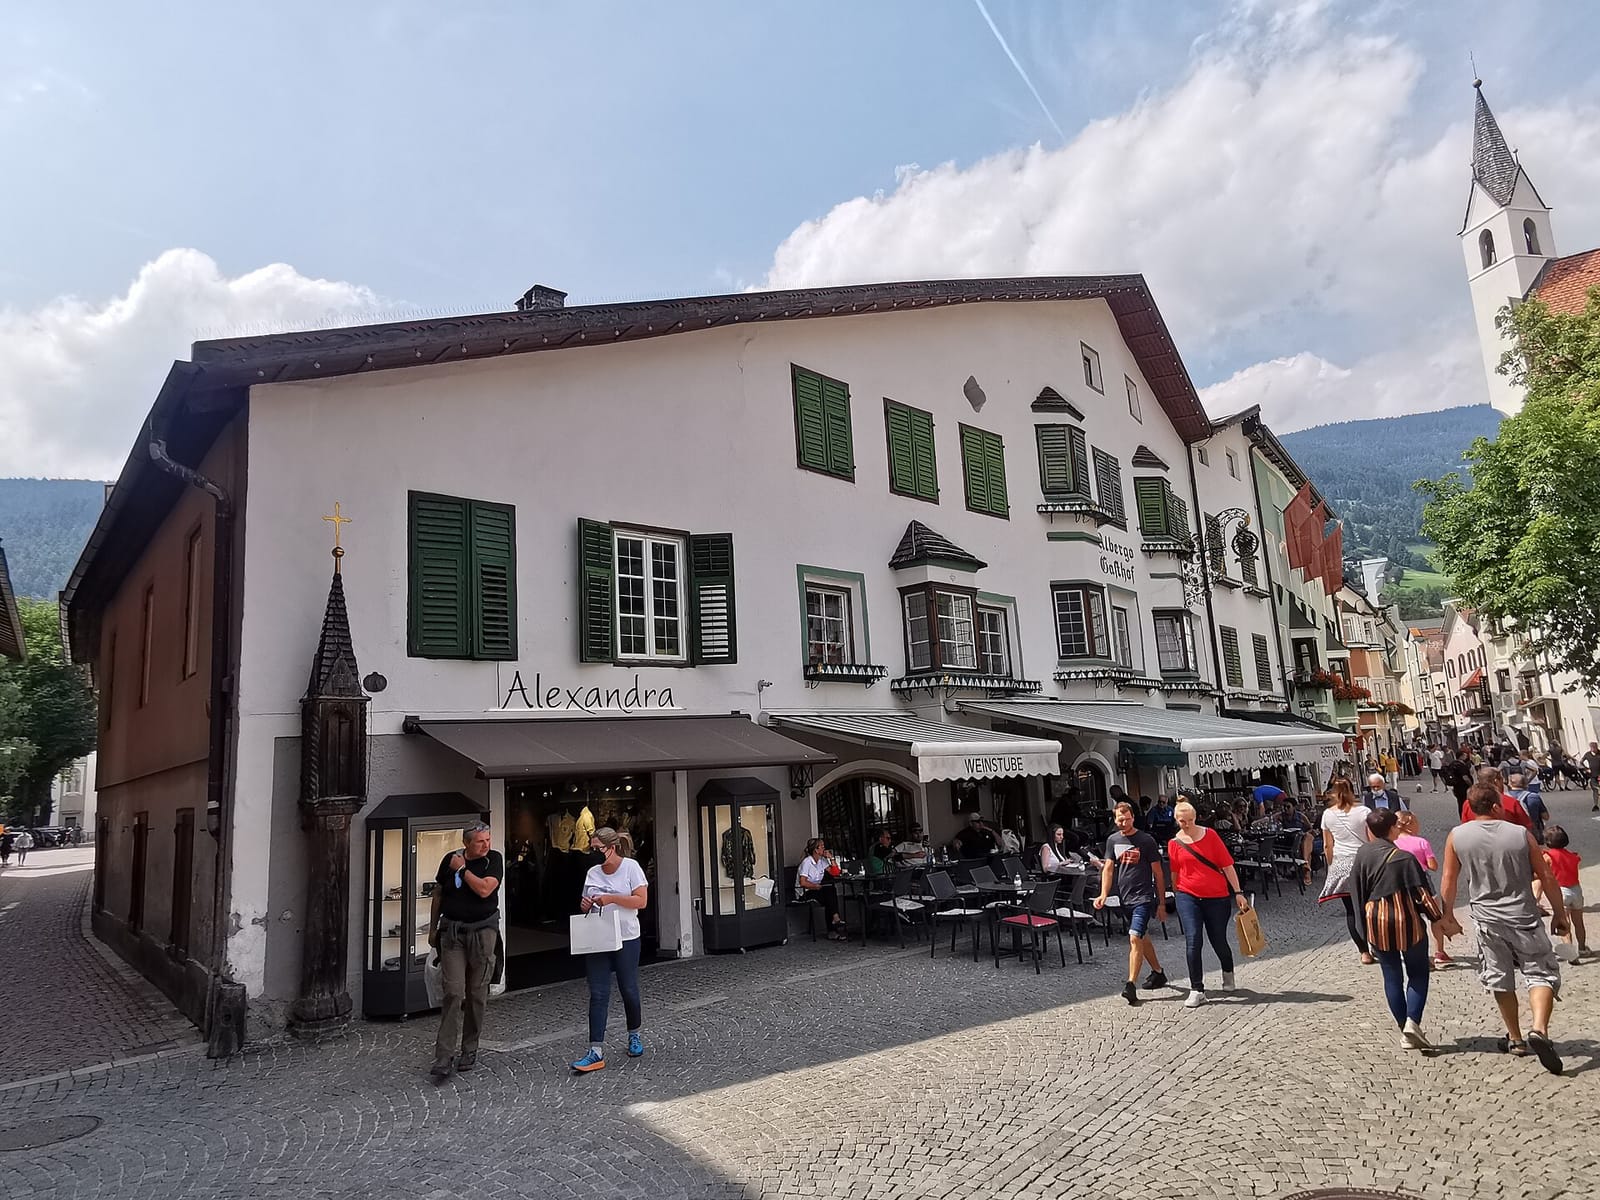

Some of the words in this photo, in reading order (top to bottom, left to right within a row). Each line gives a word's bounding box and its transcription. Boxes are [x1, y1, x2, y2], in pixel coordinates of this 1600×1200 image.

[502, 671, 675, 714] Alexandra
[965, 757, 1024, 773] WEINSTUBE
[1198, 754, 1214, 768] BAR
[1259, 748, 1295, 763] SCHWEMME
